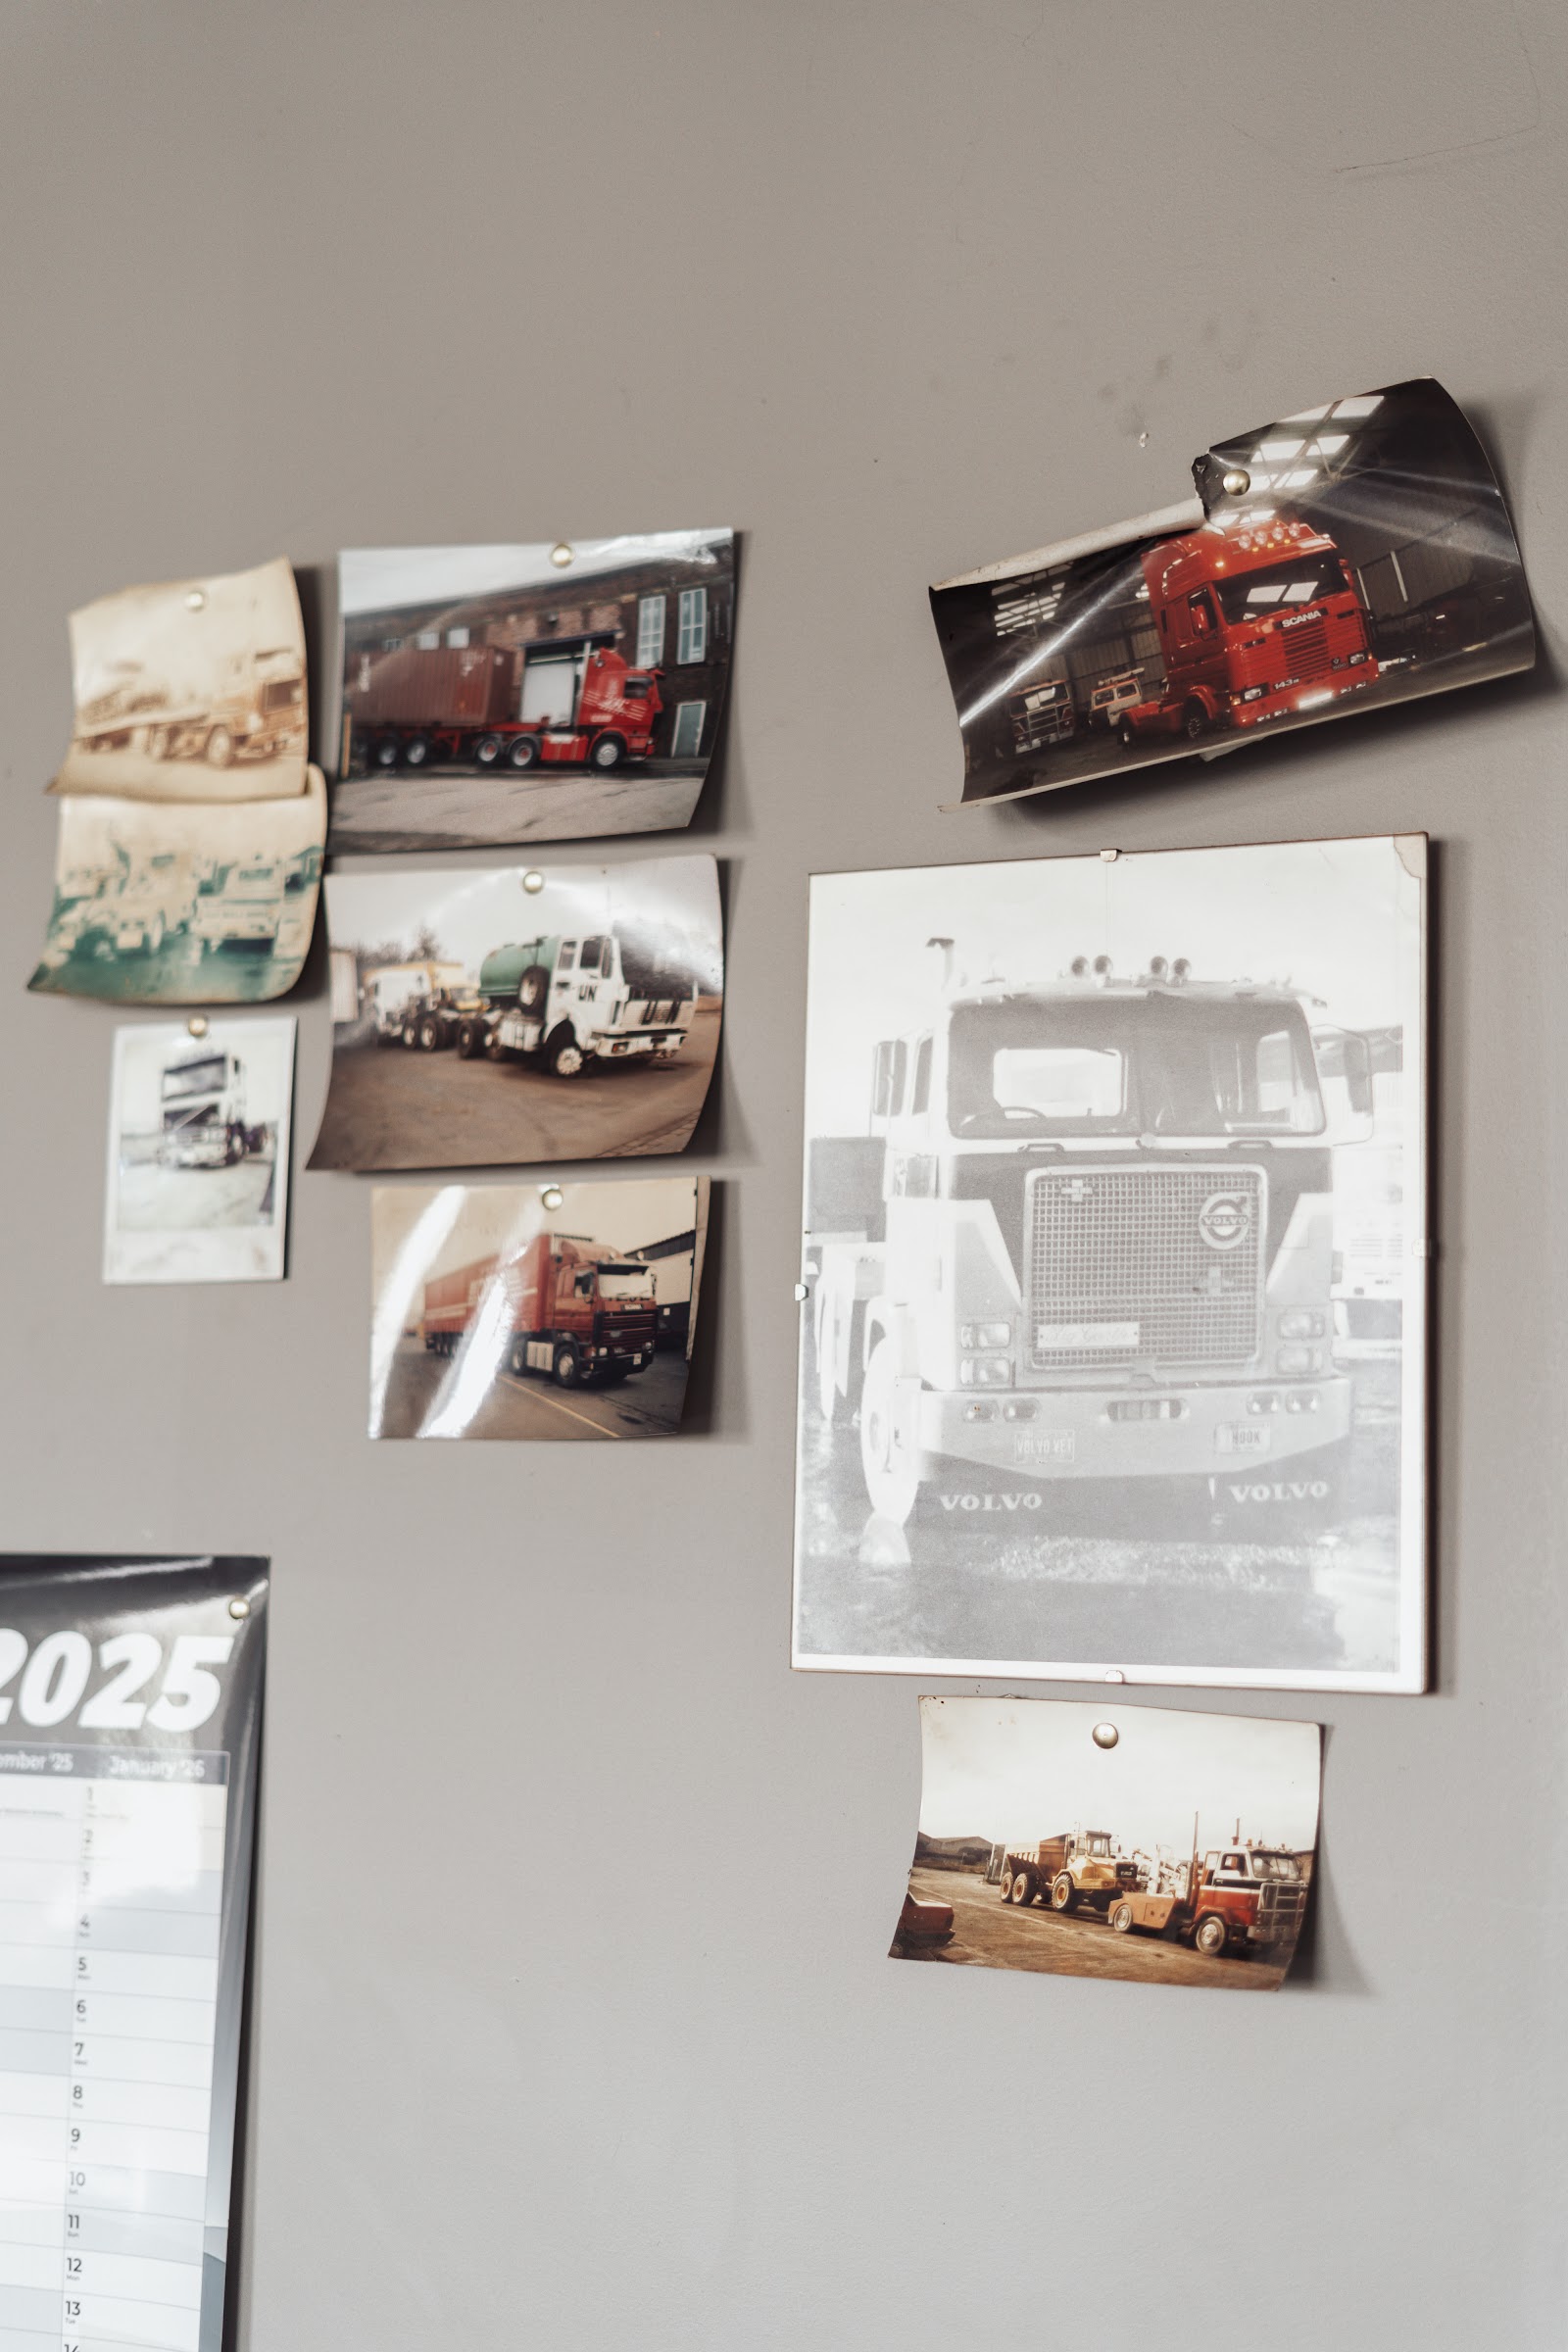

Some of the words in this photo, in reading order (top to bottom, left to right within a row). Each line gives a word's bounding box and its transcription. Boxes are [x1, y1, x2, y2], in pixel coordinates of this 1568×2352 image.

[1282, 611, 1321, 628] SCANIA
[579, 984, 598, 1004] UN
[1204, 1216, 1247, 1225] VOLVO
[1229, 1480, 1328, 1503] VOLVO
[939, 1493, 1043, 1511] VOLVO
[109, 1754, 175, 1779] January
[80, 1914, 90, 1929] 4
[77, 1956, 87, 1972] 5
[75, 1999, 86, 2014] 6
[74, 2042, 84, 2057] 7
[73, 2084, 82, 2099] 8
[71, 2128, 80, 2143] 9
[69, 2171, 85, 2186] 10
[68, 2214, 80, 2230] 11
[67, 2257, 82, 2273] 12
[65, 2300, 81, 2316] 13
